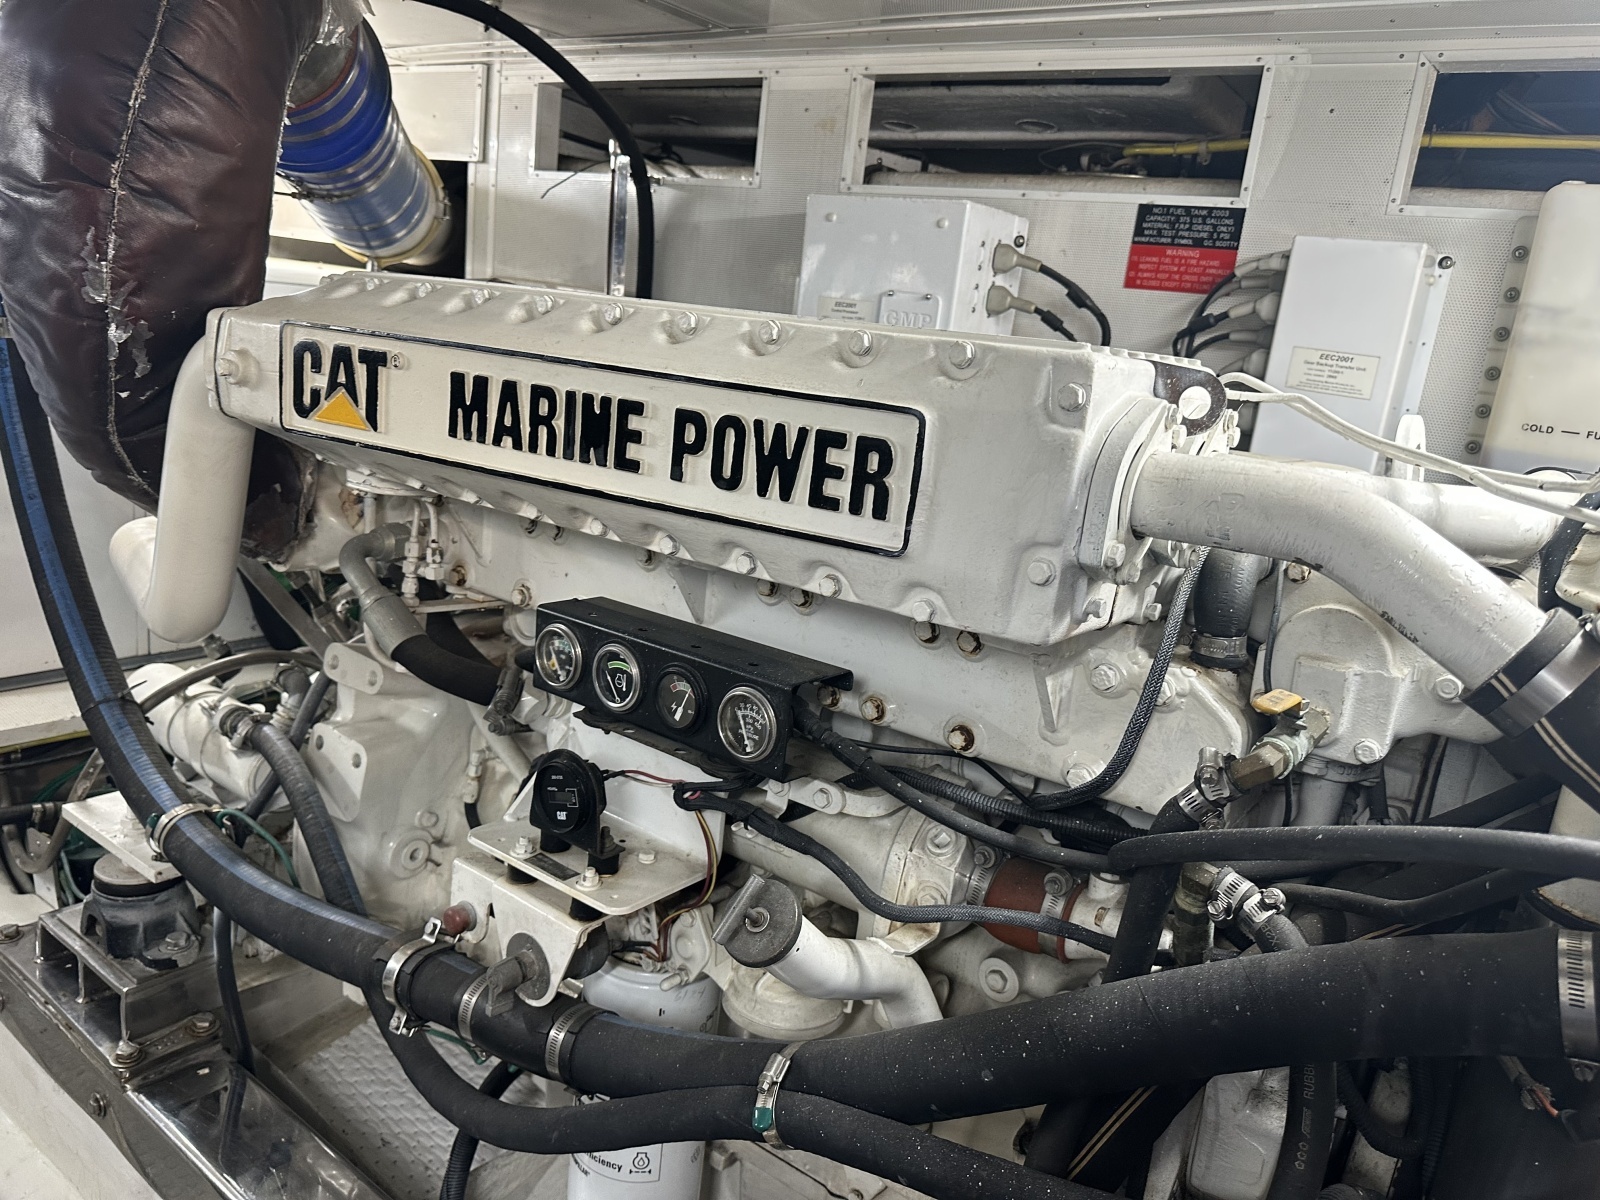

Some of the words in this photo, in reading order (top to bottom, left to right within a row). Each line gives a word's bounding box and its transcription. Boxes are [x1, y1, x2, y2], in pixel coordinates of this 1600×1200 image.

[1169, 208, 1186, 216] FUEL
[1166, 248, 1200, 258] WARNING
[884, 309, 933, 329] GMP
[1319, 353, 1354, 364] EEC2001
[1522, 423, 1554, 434] COLD
[448, 371, 646, 473] MARINE
[670, 407, 895, 521] POWER
[556, 811, 568, 820] CAT
